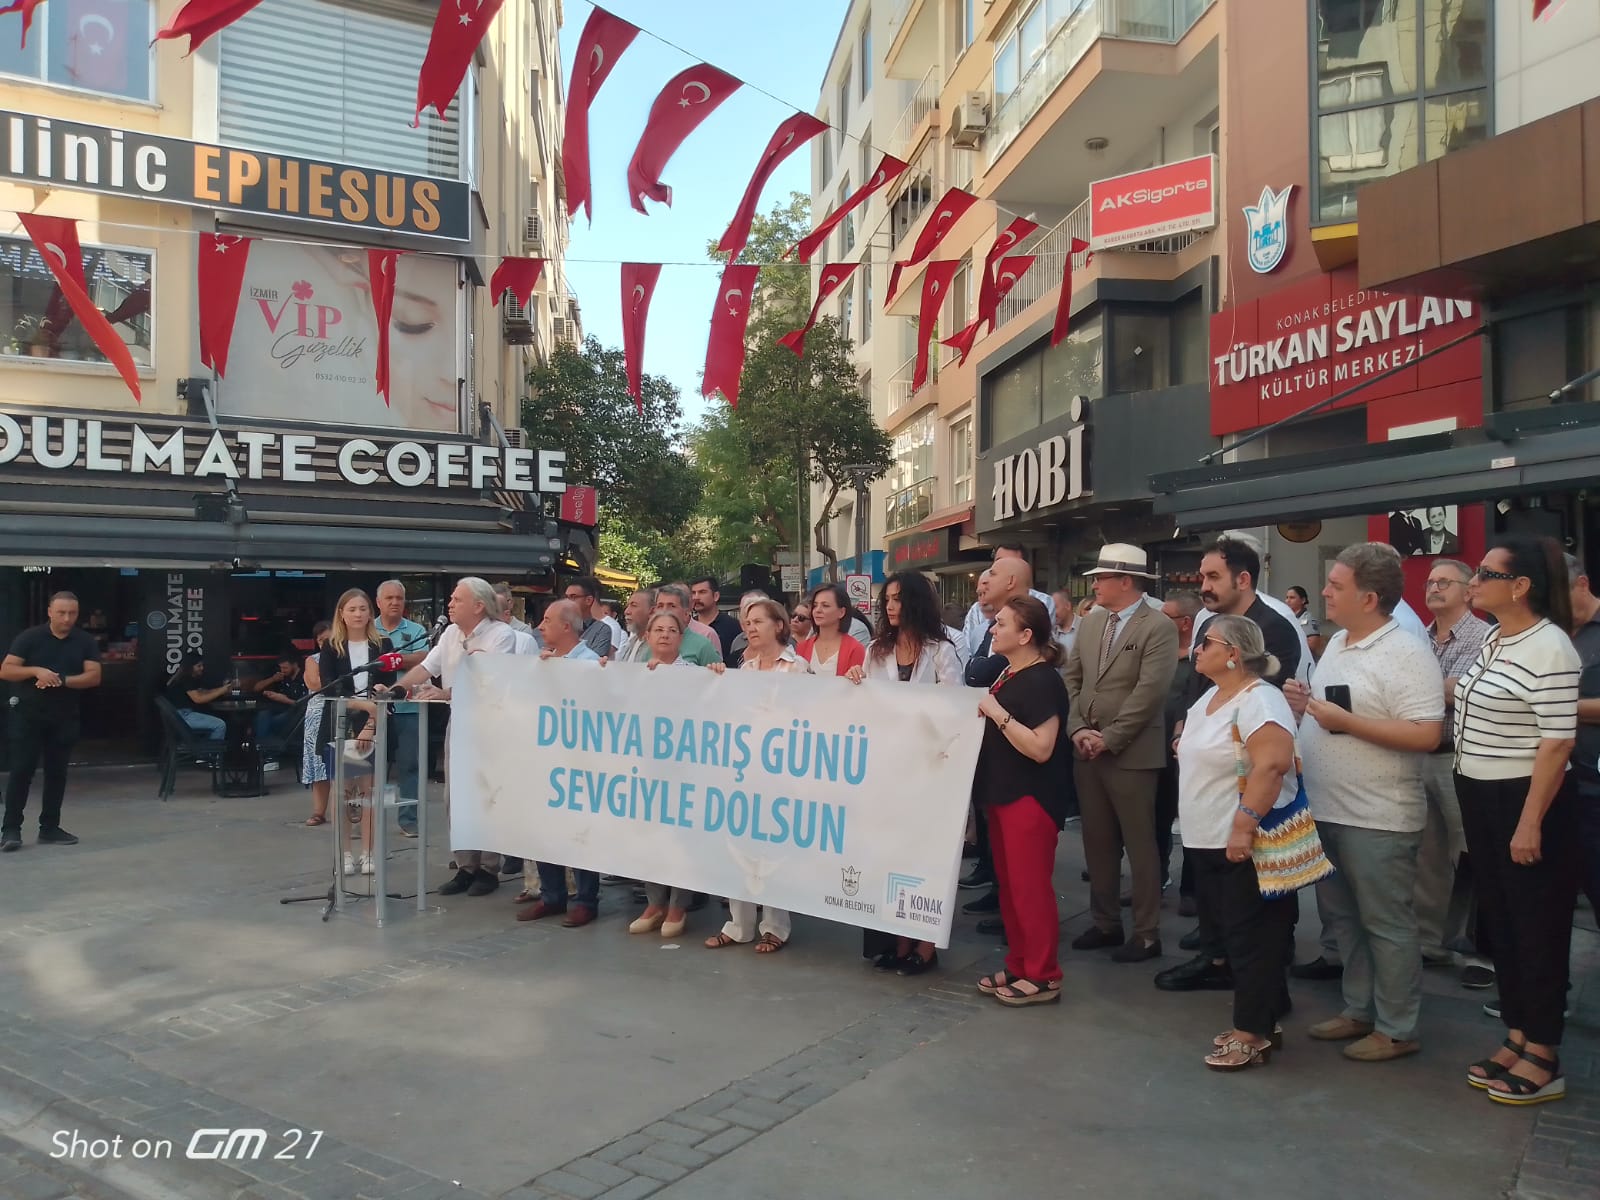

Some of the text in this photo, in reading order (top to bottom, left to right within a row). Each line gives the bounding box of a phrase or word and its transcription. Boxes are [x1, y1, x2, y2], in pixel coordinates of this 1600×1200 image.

[9, 117, 441, 232] linic EPHESUS
[1099, 179, 1208, 212] AKSigorta
[250, 286, 278, 300] İZMİR
[1277, 305, 1320, 331] KONAK
[271, 328, 367, 369] Güzellik
[1214, 295, 1472, 386] TÜRKAN SAYLAN
[1261, 339, 1424, 401] KÜLTÜR MERKEZİ
[337, 438, 567, 494] COFFEE
[166, 573, 184, 675] SOULMATE
[537, 698, 868, 785] DÜNYA BARIŞ GÜNÜ
[547, 766, 846, 855] SEVGİYLE DOLSUN
[824, 895, 876, 916] KONAK BELEDİYESİ
[910, 894, 943, 915] KONAK
